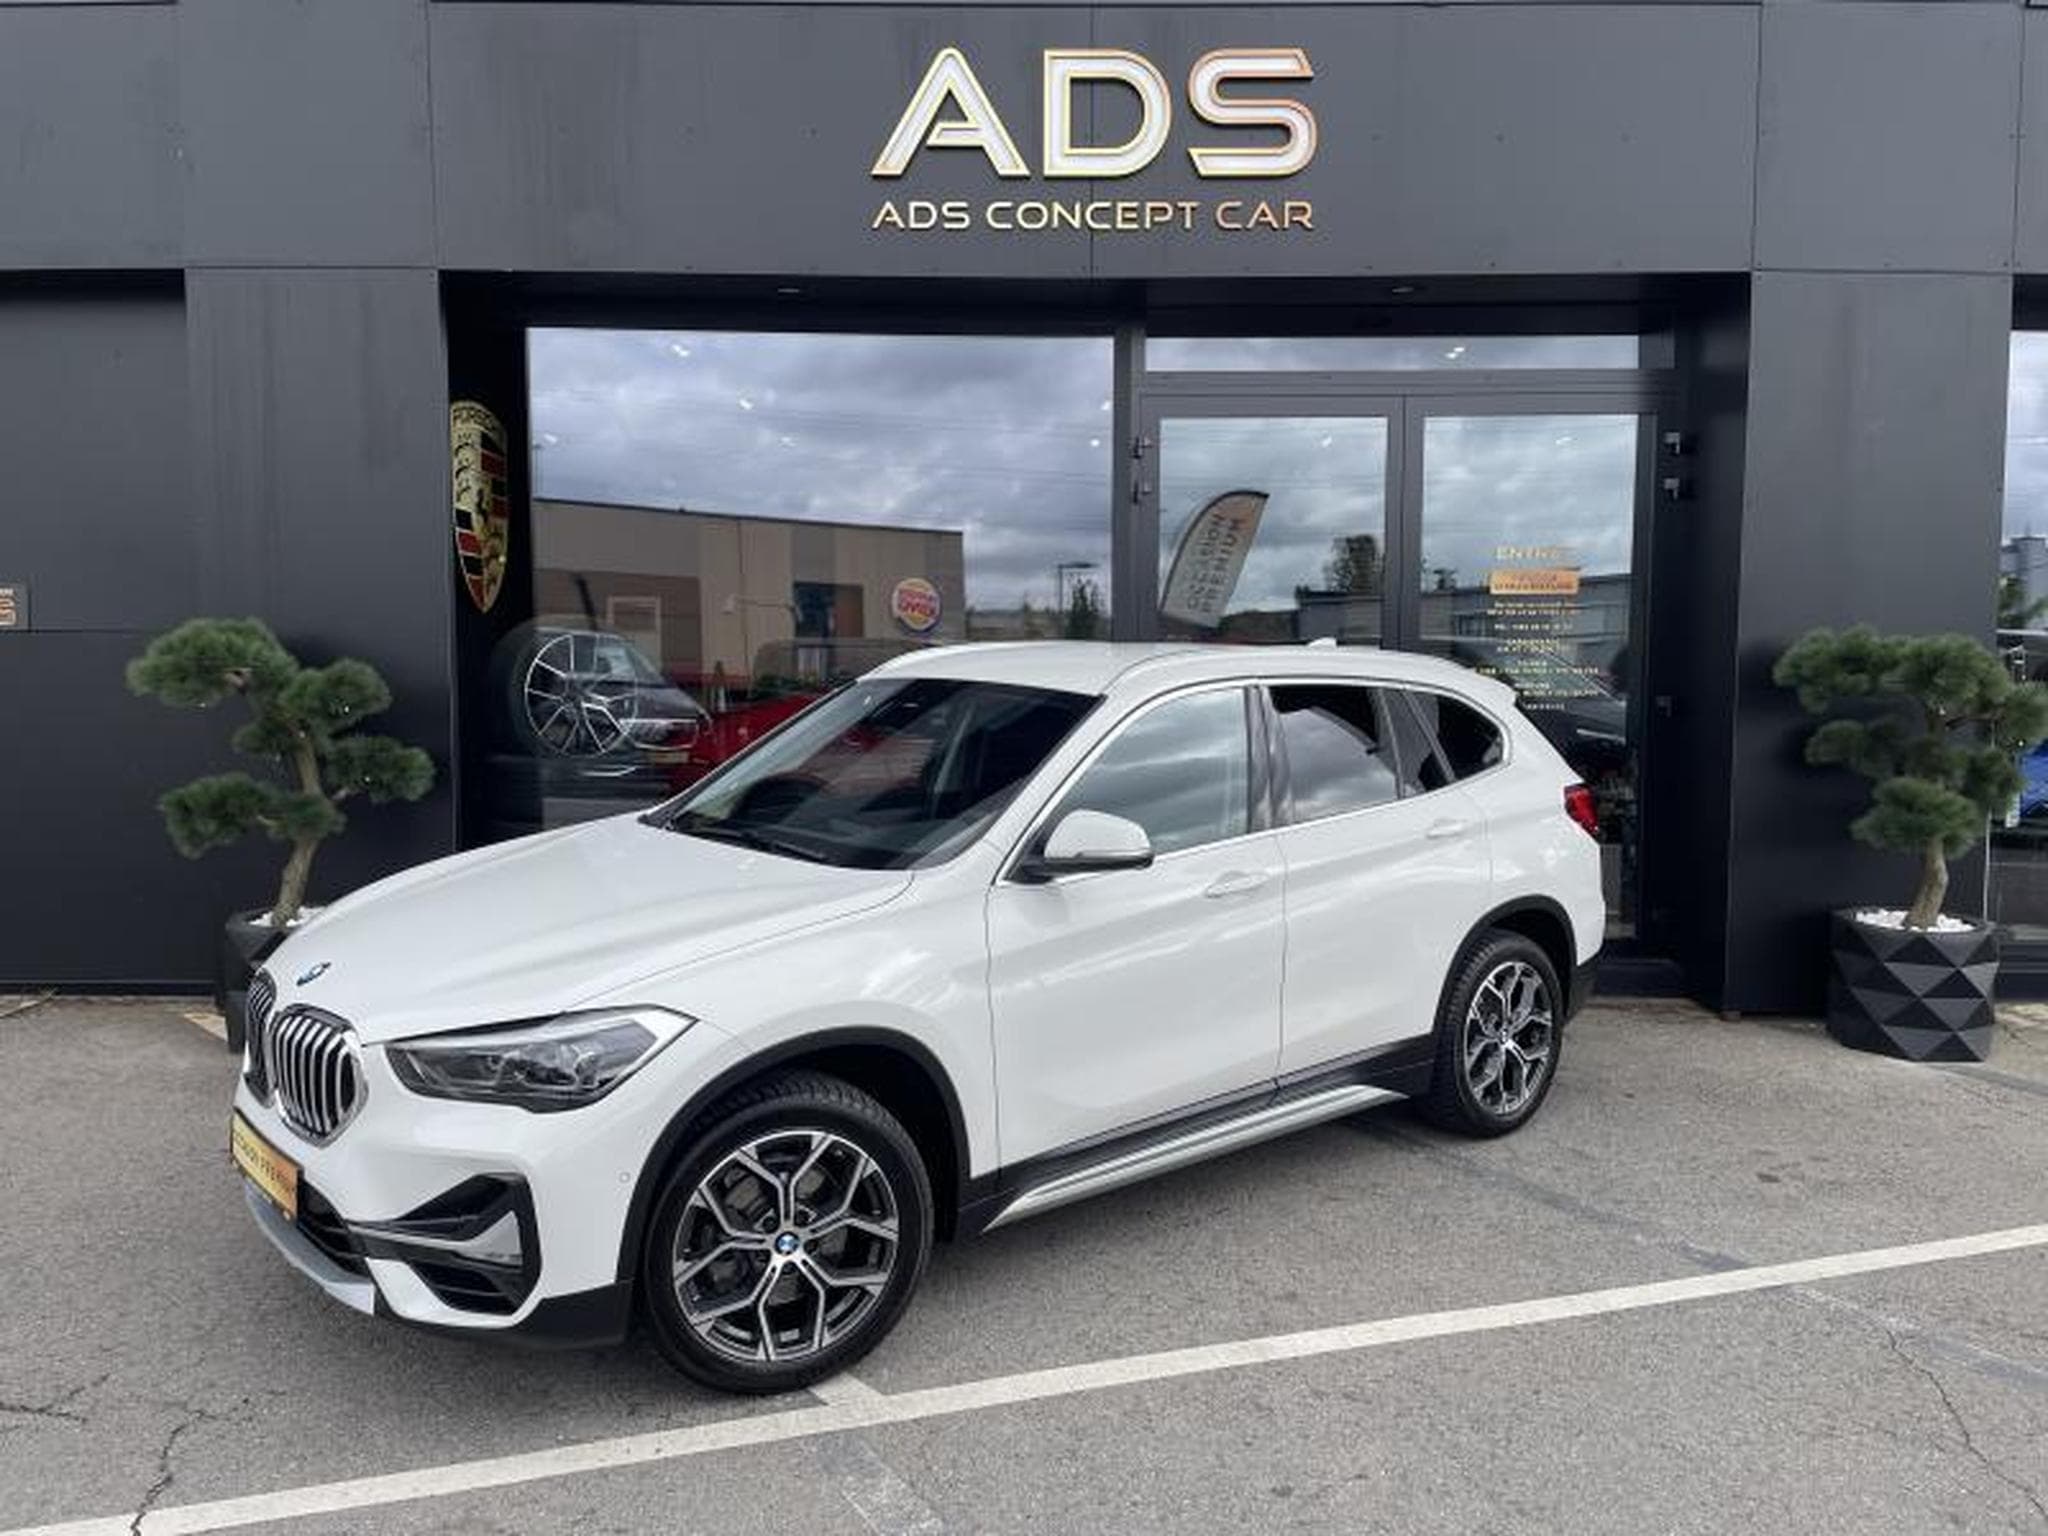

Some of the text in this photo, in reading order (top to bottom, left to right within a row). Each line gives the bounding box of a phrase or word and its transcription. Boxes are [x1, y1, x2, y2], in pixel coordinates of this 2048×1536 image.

[871, 46, 1317, 177] ADS
[872, 201, 1315, 231] ADS CONCEPT CAR
